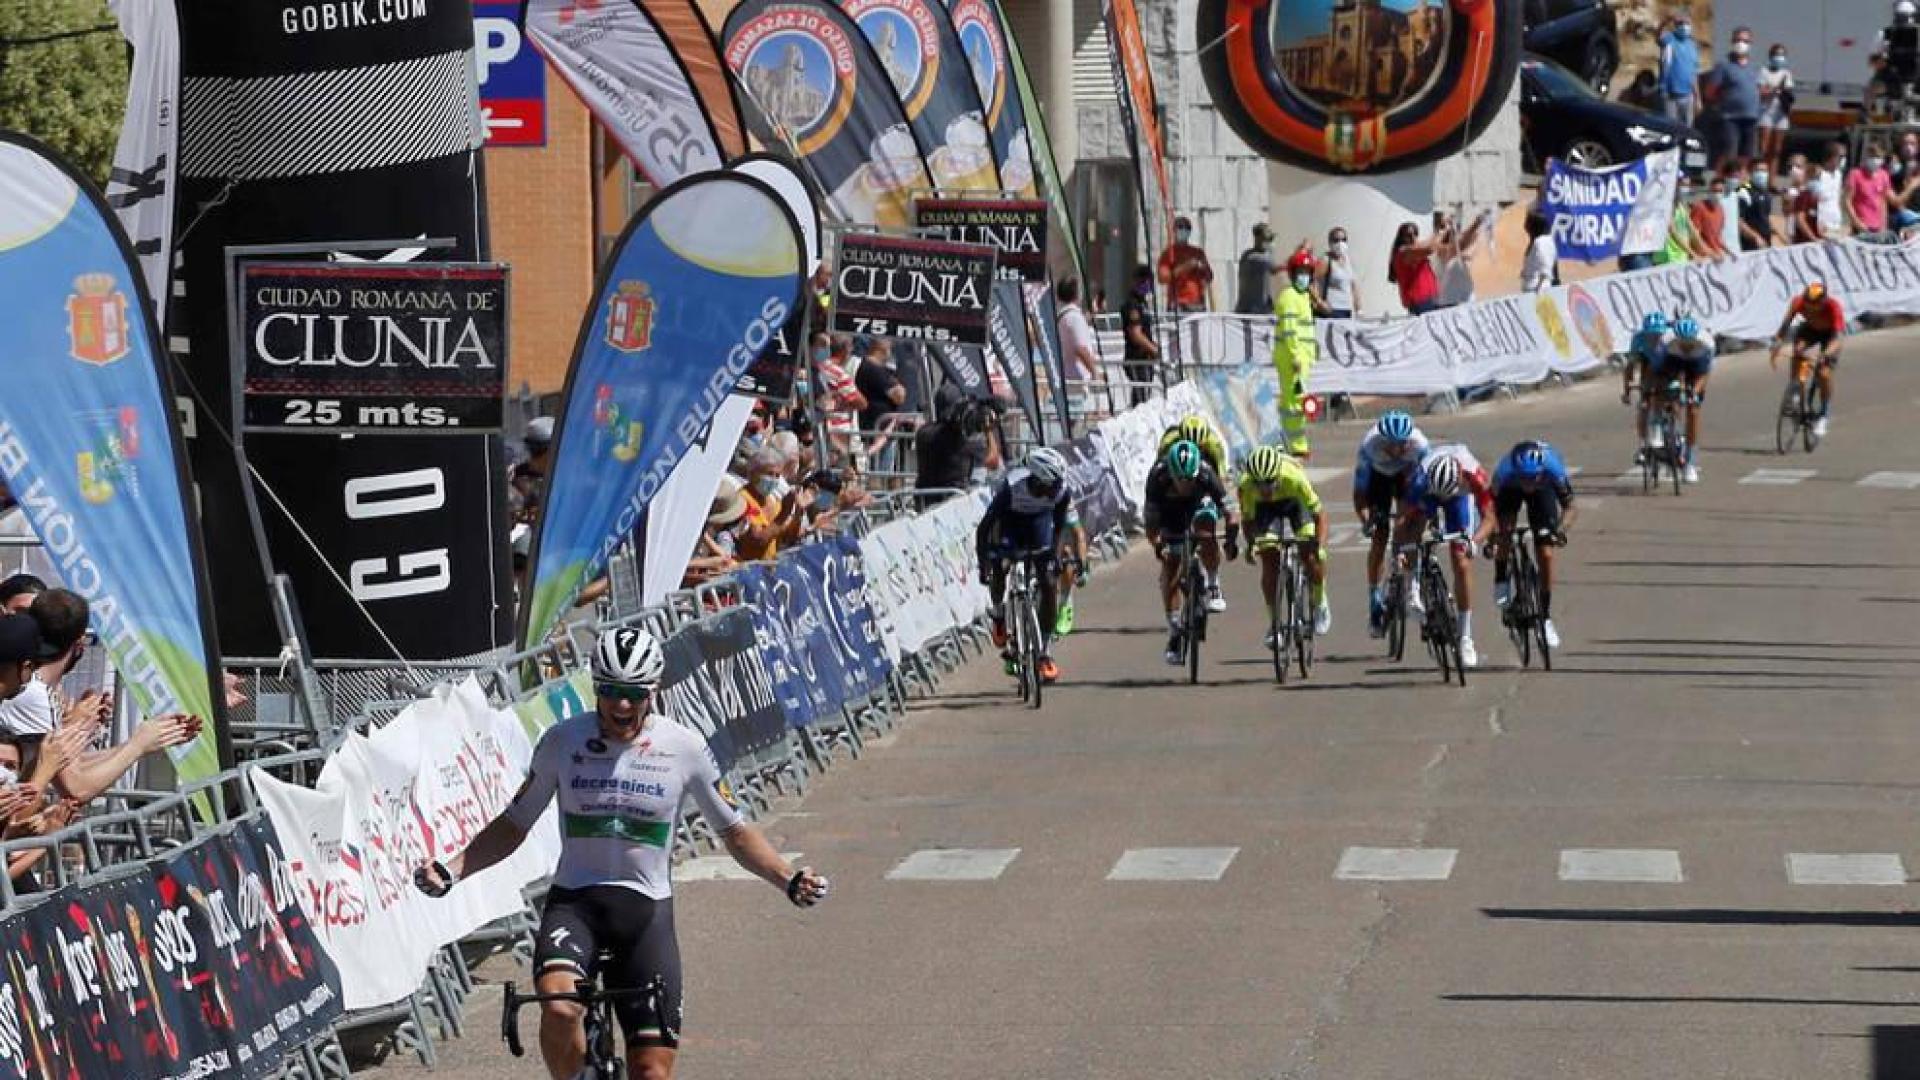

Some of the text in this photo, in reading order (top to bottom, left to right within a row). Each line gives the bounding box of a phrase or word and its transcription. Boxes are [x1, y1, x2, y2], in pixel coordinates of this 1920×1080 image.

[282, 0, 428, 33] GOBIK.COM
[475, 17, 521, 84] P
[1547, 171, 1641, 206] SANIDAD
[842, 248, 986, 275] CIUDAD ROMANA DE
[994, 264, 1026, 280] ts.
[257, 287, 495, 310] CIUDAD ROMANA DE
[838, 264, 983, 309] CLUNIA
[254, 313, 497, 370] CLUNIA
[852, 317, 960, 342] 75 mts.
[677, 295, 788, 434] BURGOS
[284, 401, 460, 427] 25 mts.
[571, 775, 666, 798] deceuninck
